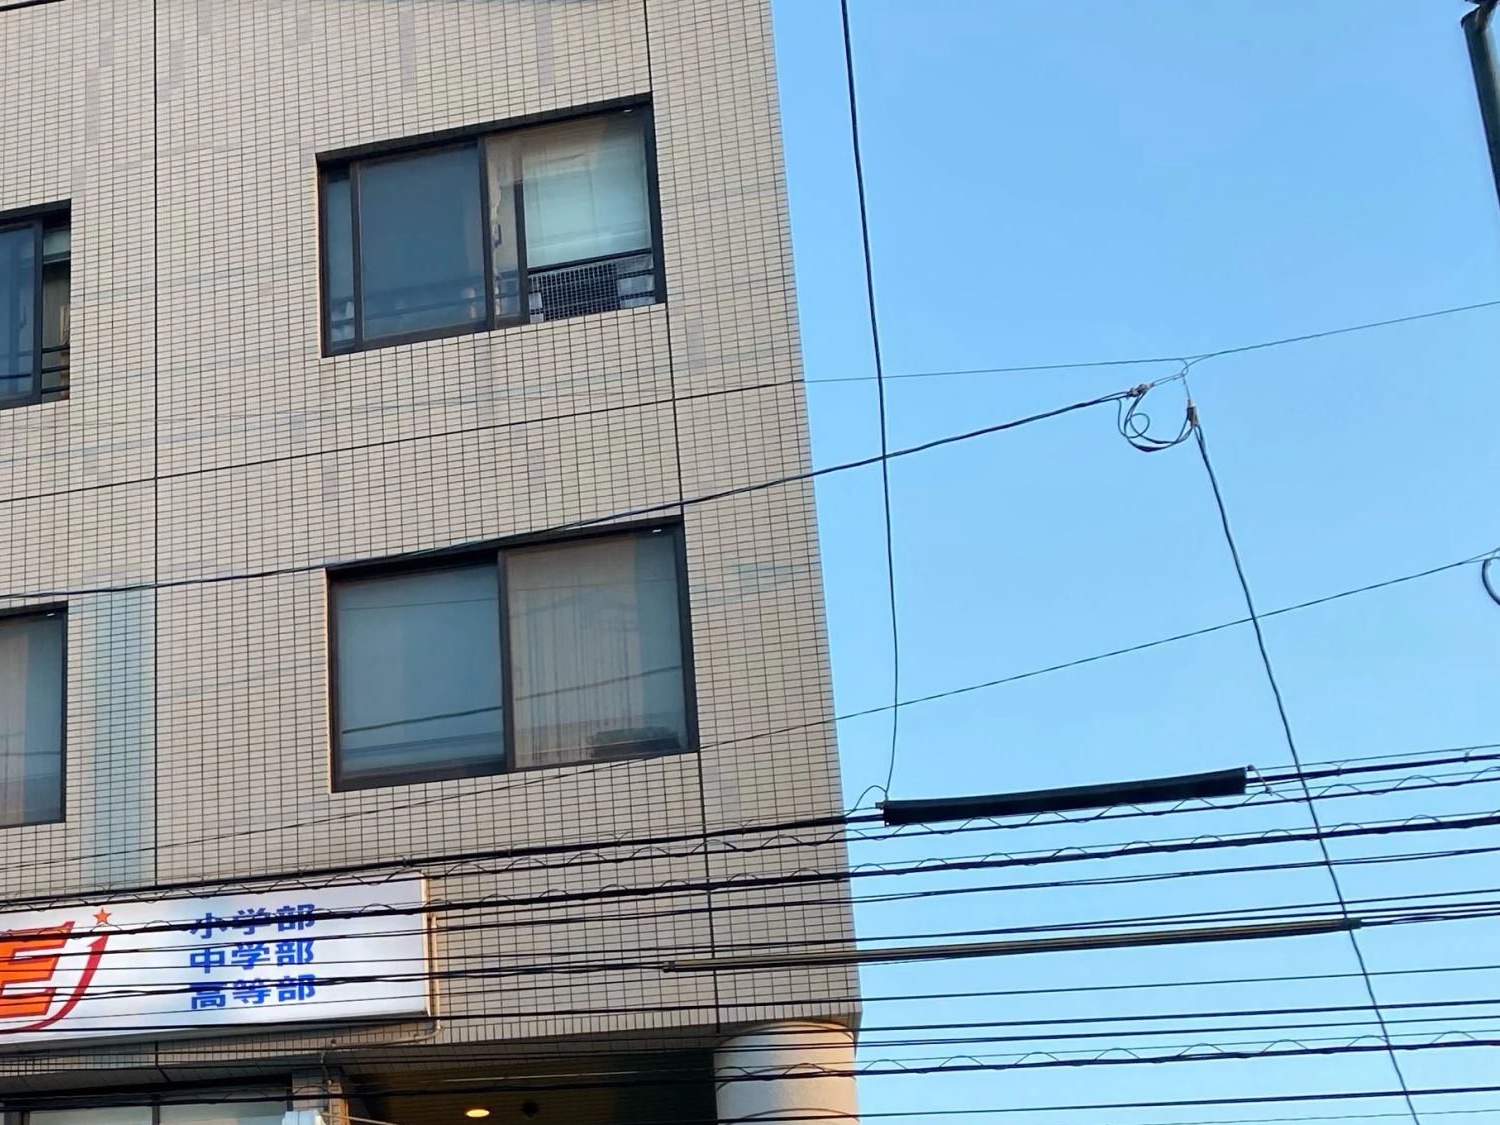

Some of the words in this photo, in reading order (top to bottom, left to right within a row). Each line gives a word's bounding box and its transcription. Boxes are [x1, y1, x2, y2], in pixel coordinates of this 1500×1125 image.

[189, 939, 315, 973] 中学部
[190, 974, 316, 1010] 高等部
